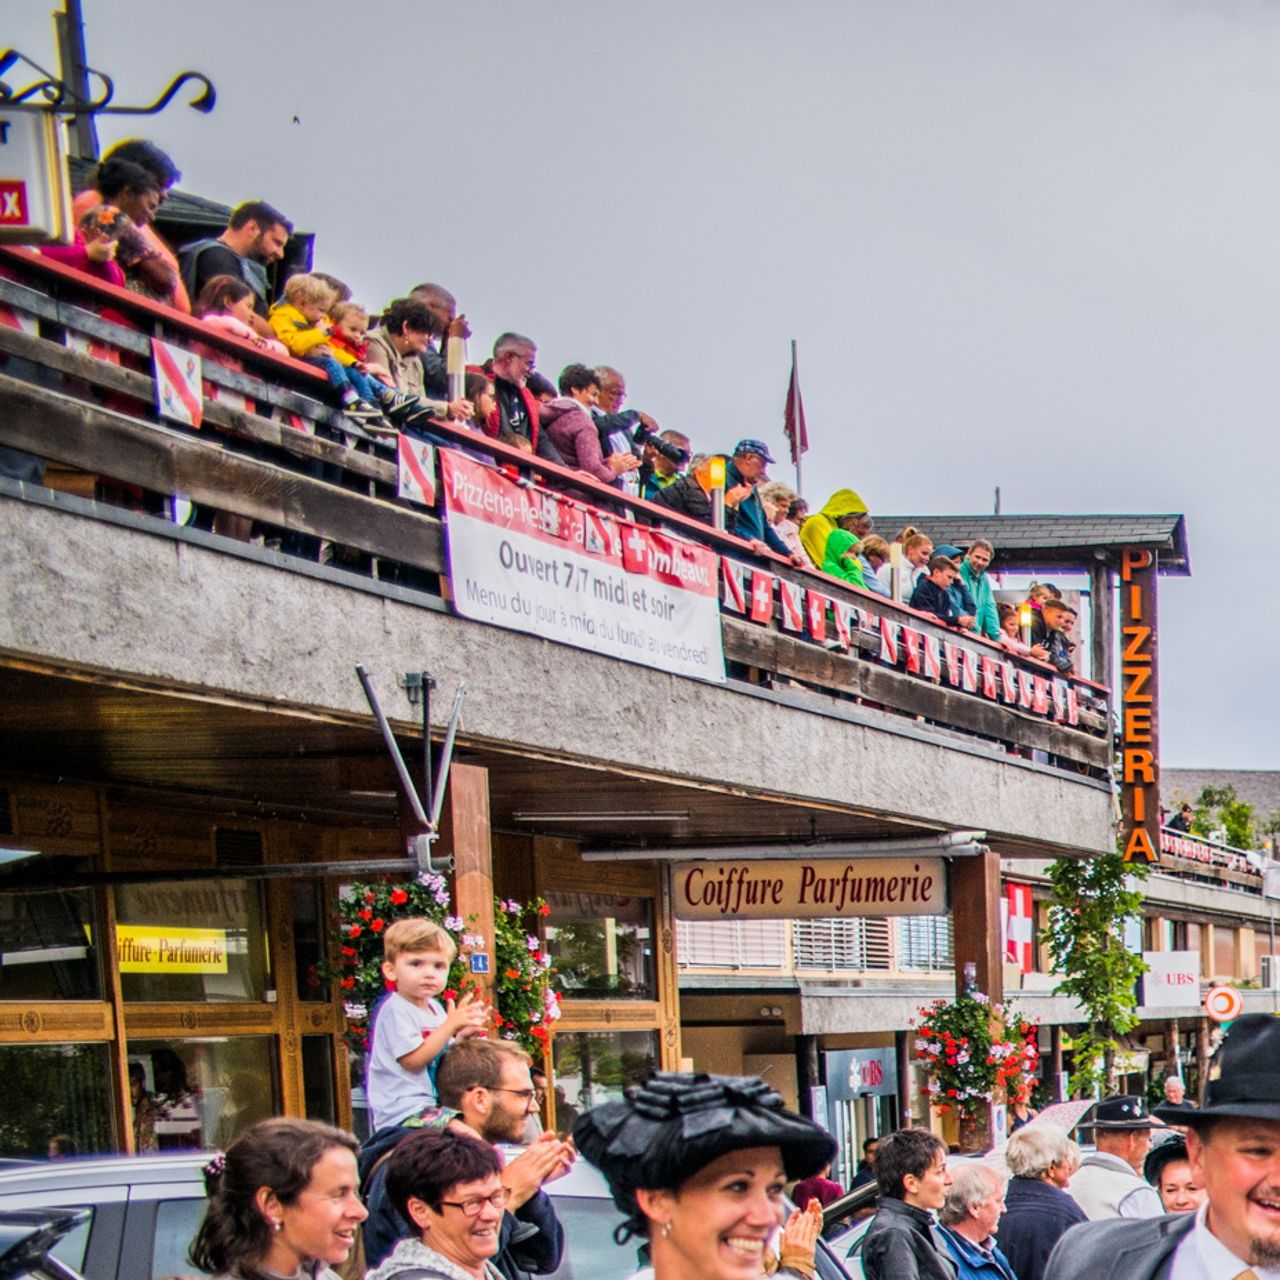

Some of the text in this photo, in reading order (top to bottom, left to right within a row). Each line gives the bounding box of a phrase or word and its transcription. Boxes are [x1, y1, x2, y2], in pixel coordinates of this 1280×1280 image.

[466, 578, 506, 609] Menu
[511, 591, 531, 615] du
[500, 540, 674, 622] Ouvert 7/7 midi et soir
[1121, 549, 1158, 862] PIZZERIA
[684, 867, 784, 913] Coiffure
[797, 863, 932, 912] Parfumerie
[1166, 972, 1194, 986] UBS
[862, 1060, 884, 1087] UBS
